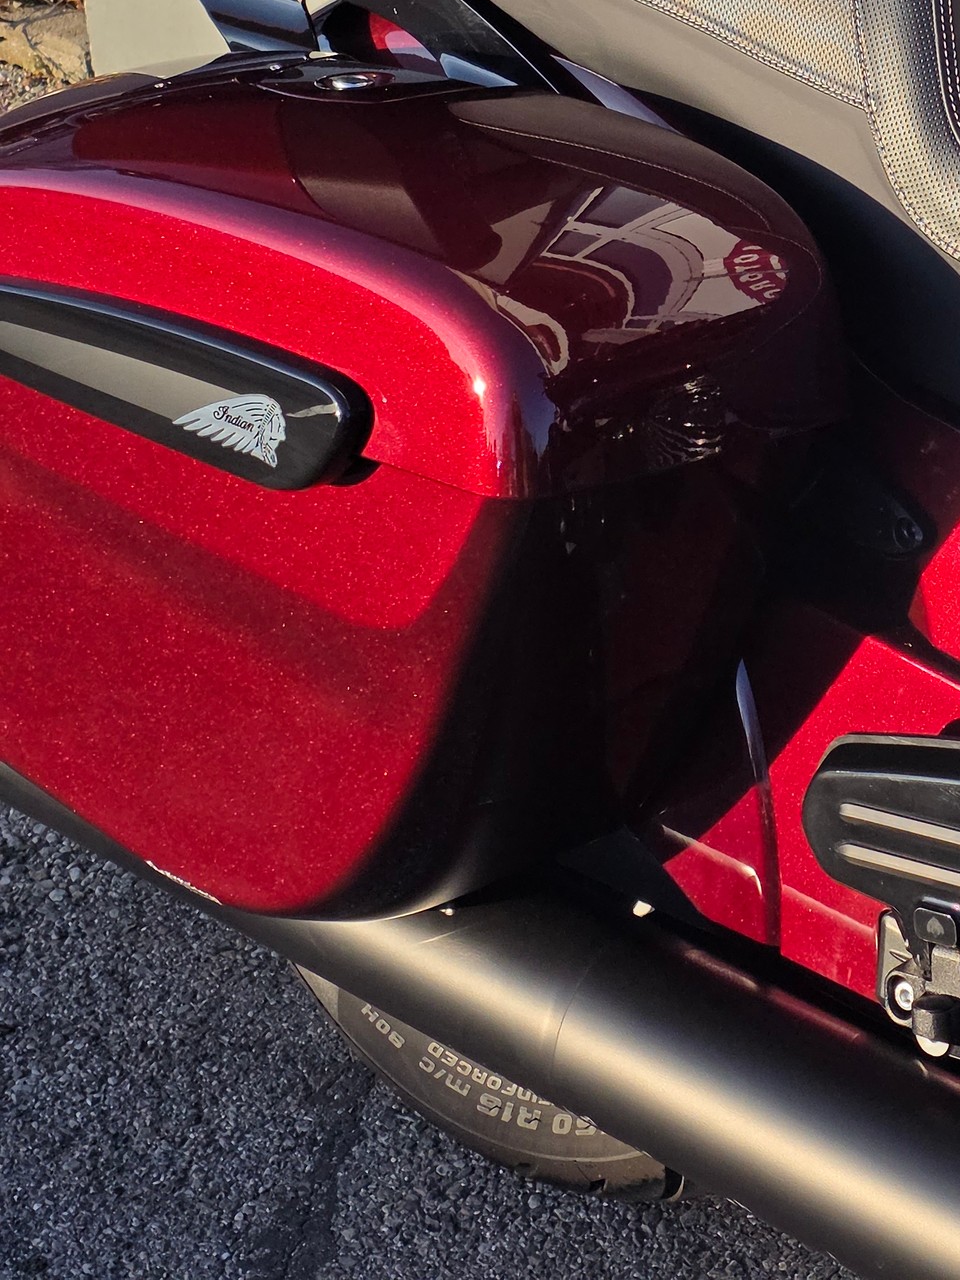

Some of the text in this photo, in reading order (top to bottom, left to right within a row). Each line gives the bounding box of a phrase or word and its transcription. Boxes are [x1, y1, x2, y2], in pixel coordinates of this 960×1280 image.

[213, 405, 255, 433] Indian
[427, 1041, 555, 1108] INFORCED
[476, 1092, 542, 1130] R16
